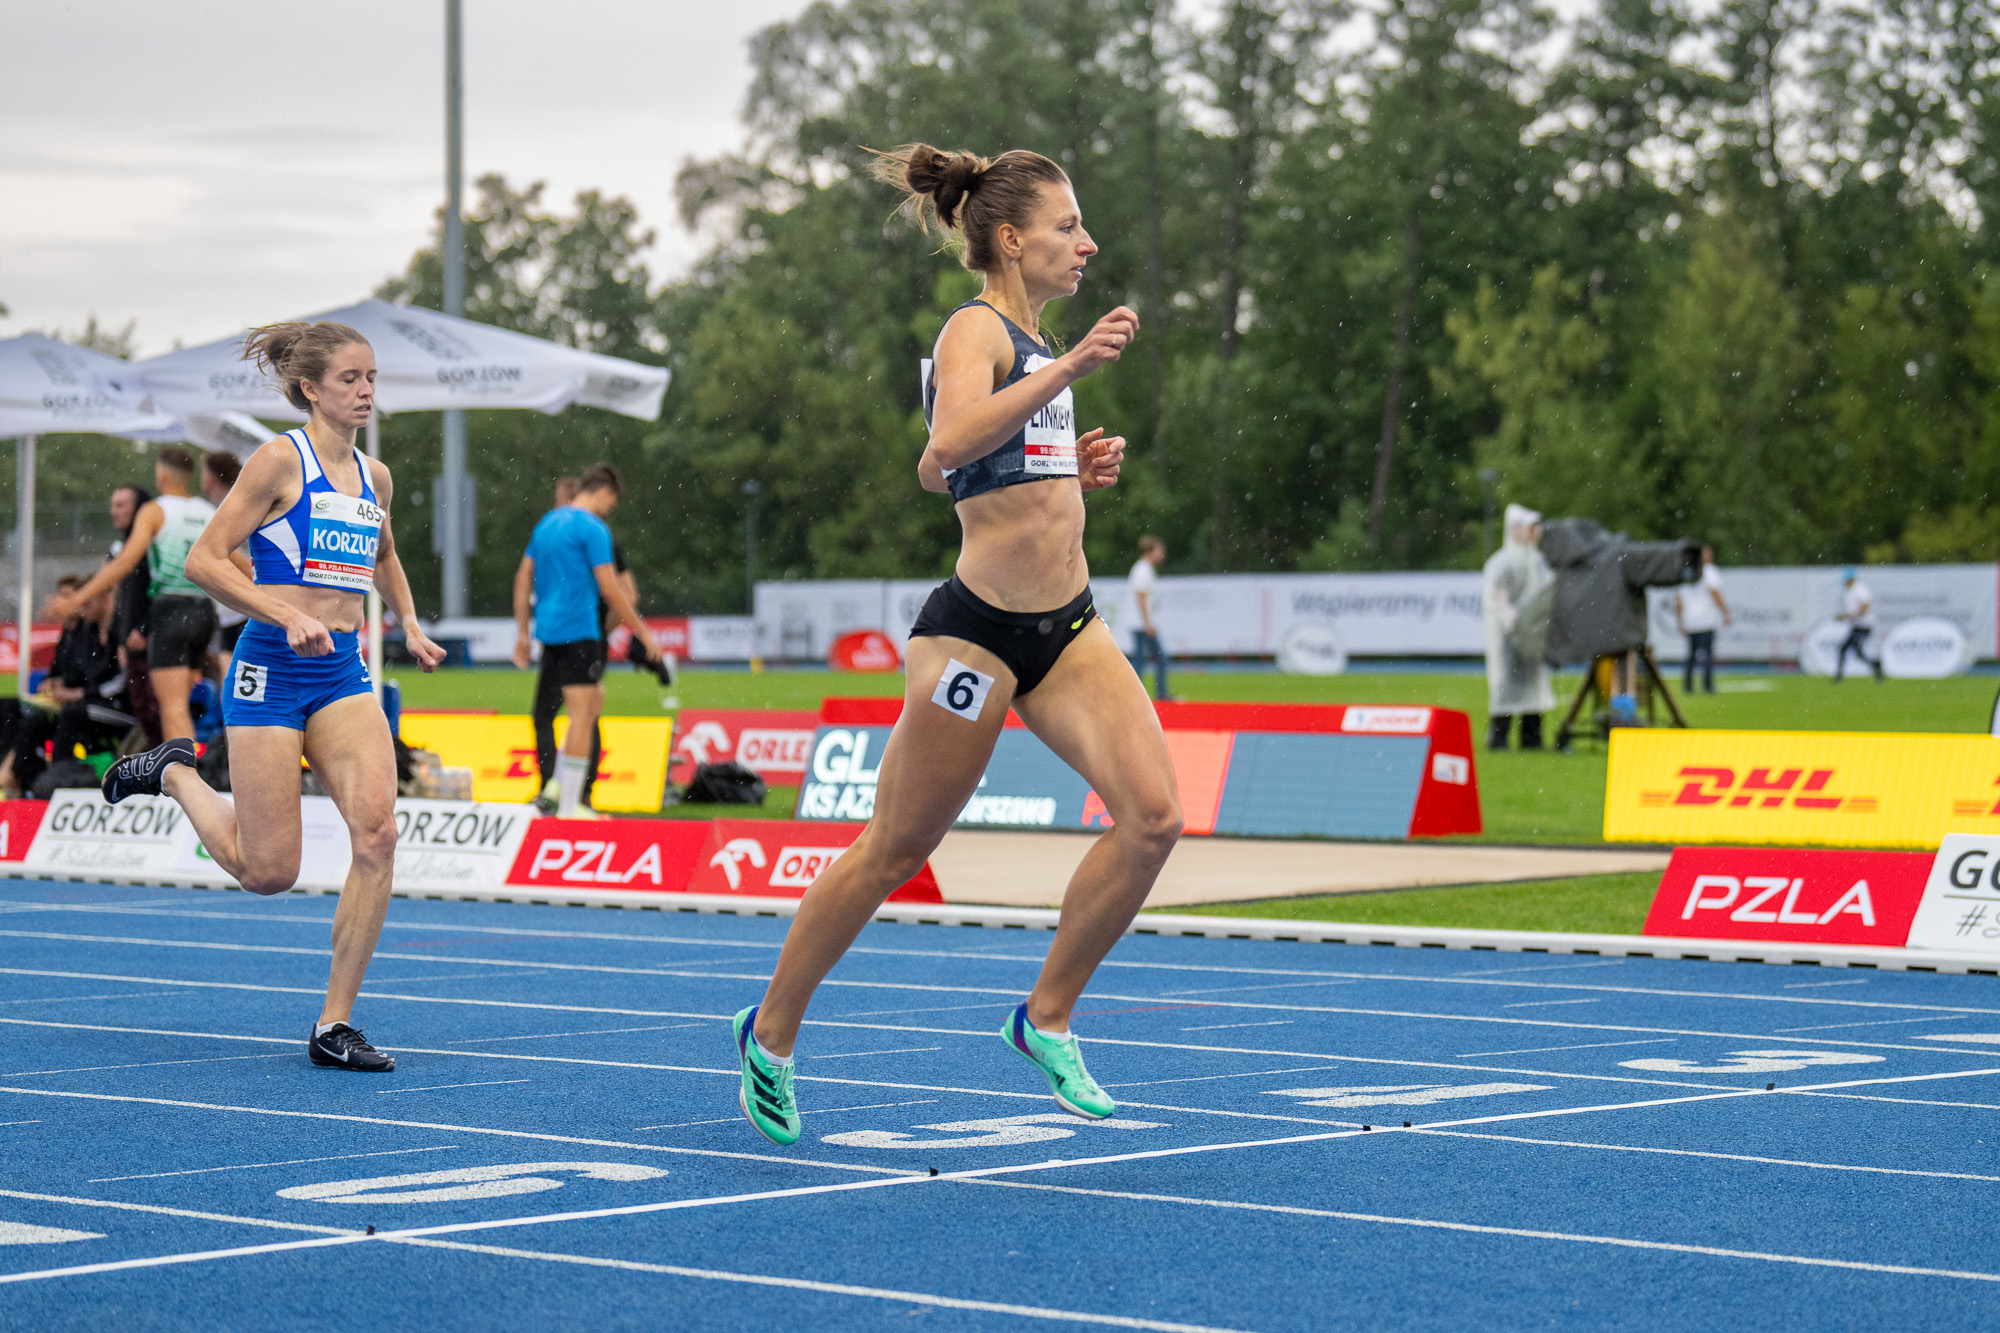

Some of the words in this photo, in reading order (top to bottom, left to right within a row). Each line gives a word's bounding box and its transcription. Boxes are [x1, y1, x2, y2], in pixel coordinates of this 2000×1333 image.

[357, 503, 381, 522] 465
[309, 571, 338, 580] GORZÓW
[318, 562, 328, 570] 99.
[239, 665, 257, 696] 5
[947, 671, 979, 711] 6
[745, 739, 808, 762] ORLE
[801, 782, 839, 819] KS
[1673, 767, 1844, 809] DHL
[529, 839, 662, 885] PZLA
[1681, 874, 1876, 927] PZLA
[1618, 1050, 1886, 1074] 3
[820, 1113, 1173, 1149] 5
[276, 1161, 669, 1204] 6
